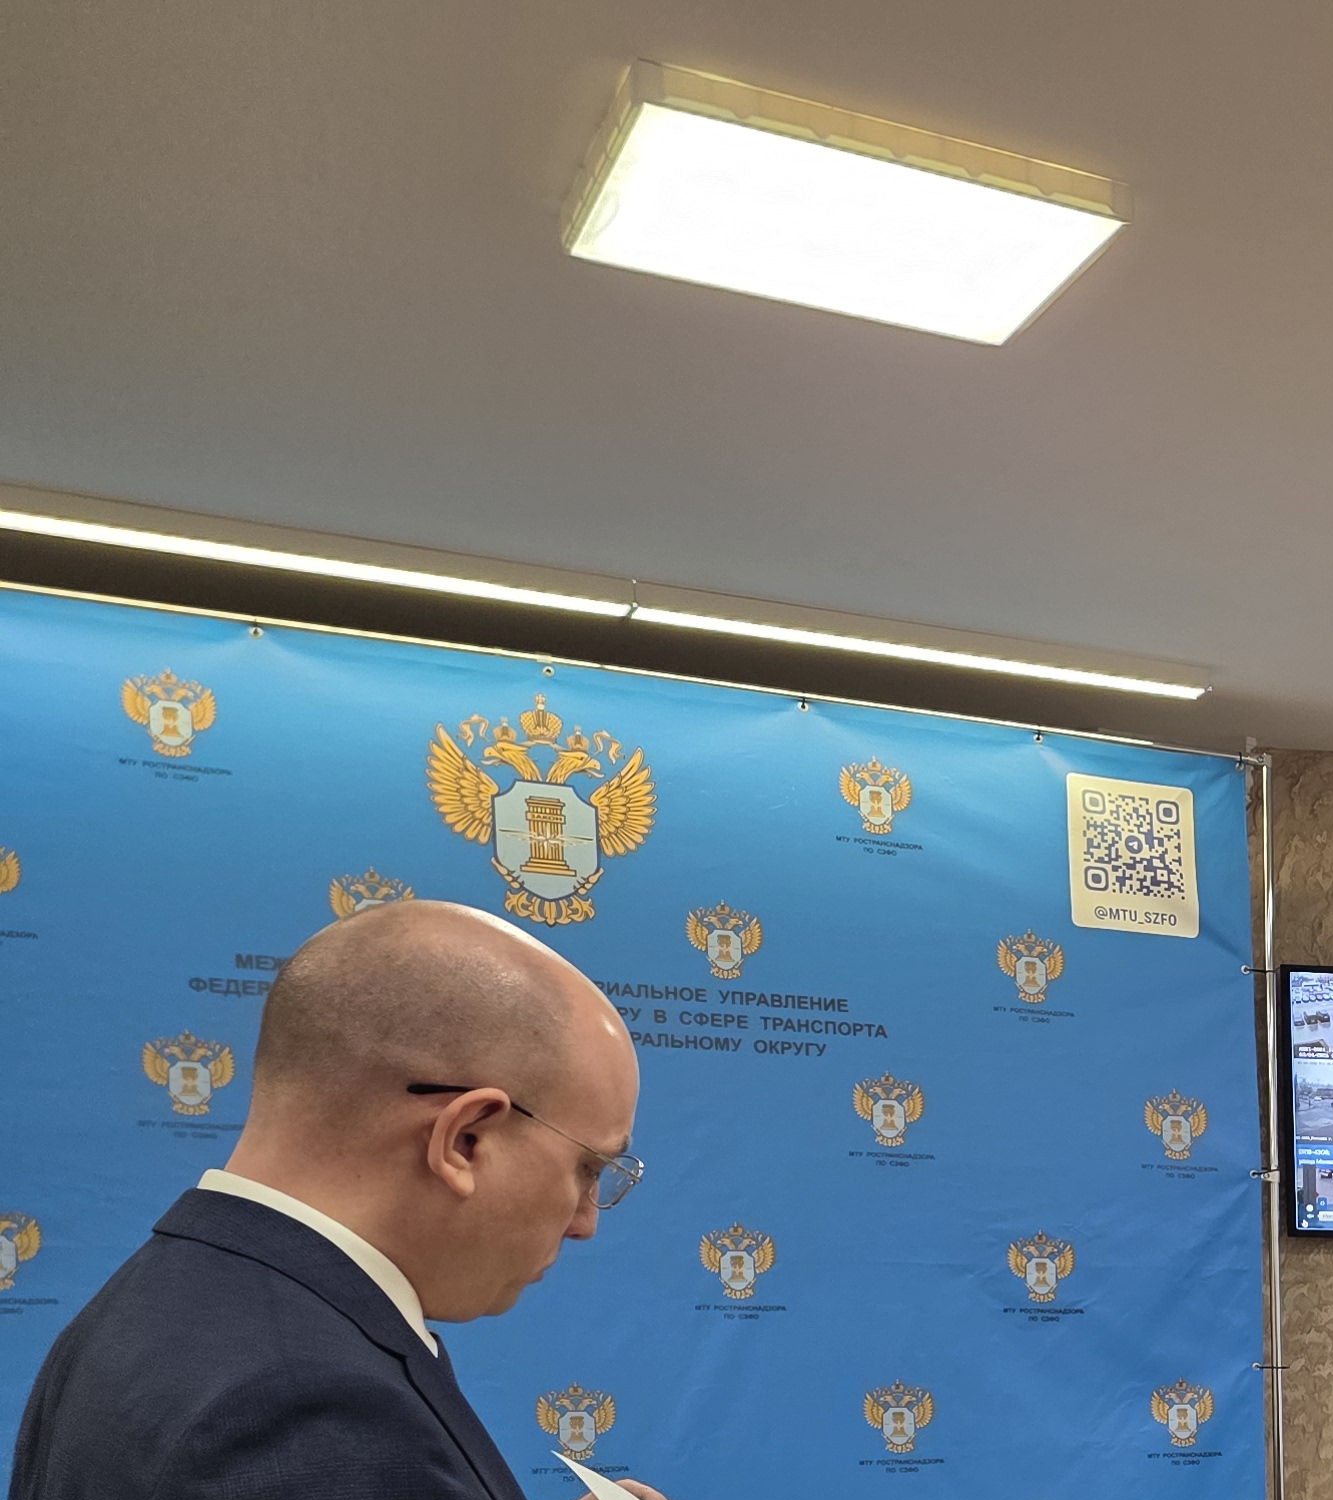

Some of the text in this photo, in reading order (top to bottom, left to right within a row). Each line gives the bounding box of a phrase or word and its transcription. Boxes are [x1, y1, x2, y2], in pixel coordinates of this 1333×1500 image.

[836, 835, 850, 843] МТУ
[1094, 906, 1177, 926] @MTU_SZFO
[188, 977, 272, 998] ФЕДЕР
[595, 980, 849, 1013] РИАЛЬНОЕ УПРАВЛЕНИЕ
[617, 1006, 888, 1039] РУ В СФЕРЕ ТРАНСПОРТА
[630, 1031, 827, 1057] РАЛЬНОМУ ОКРУГУ
